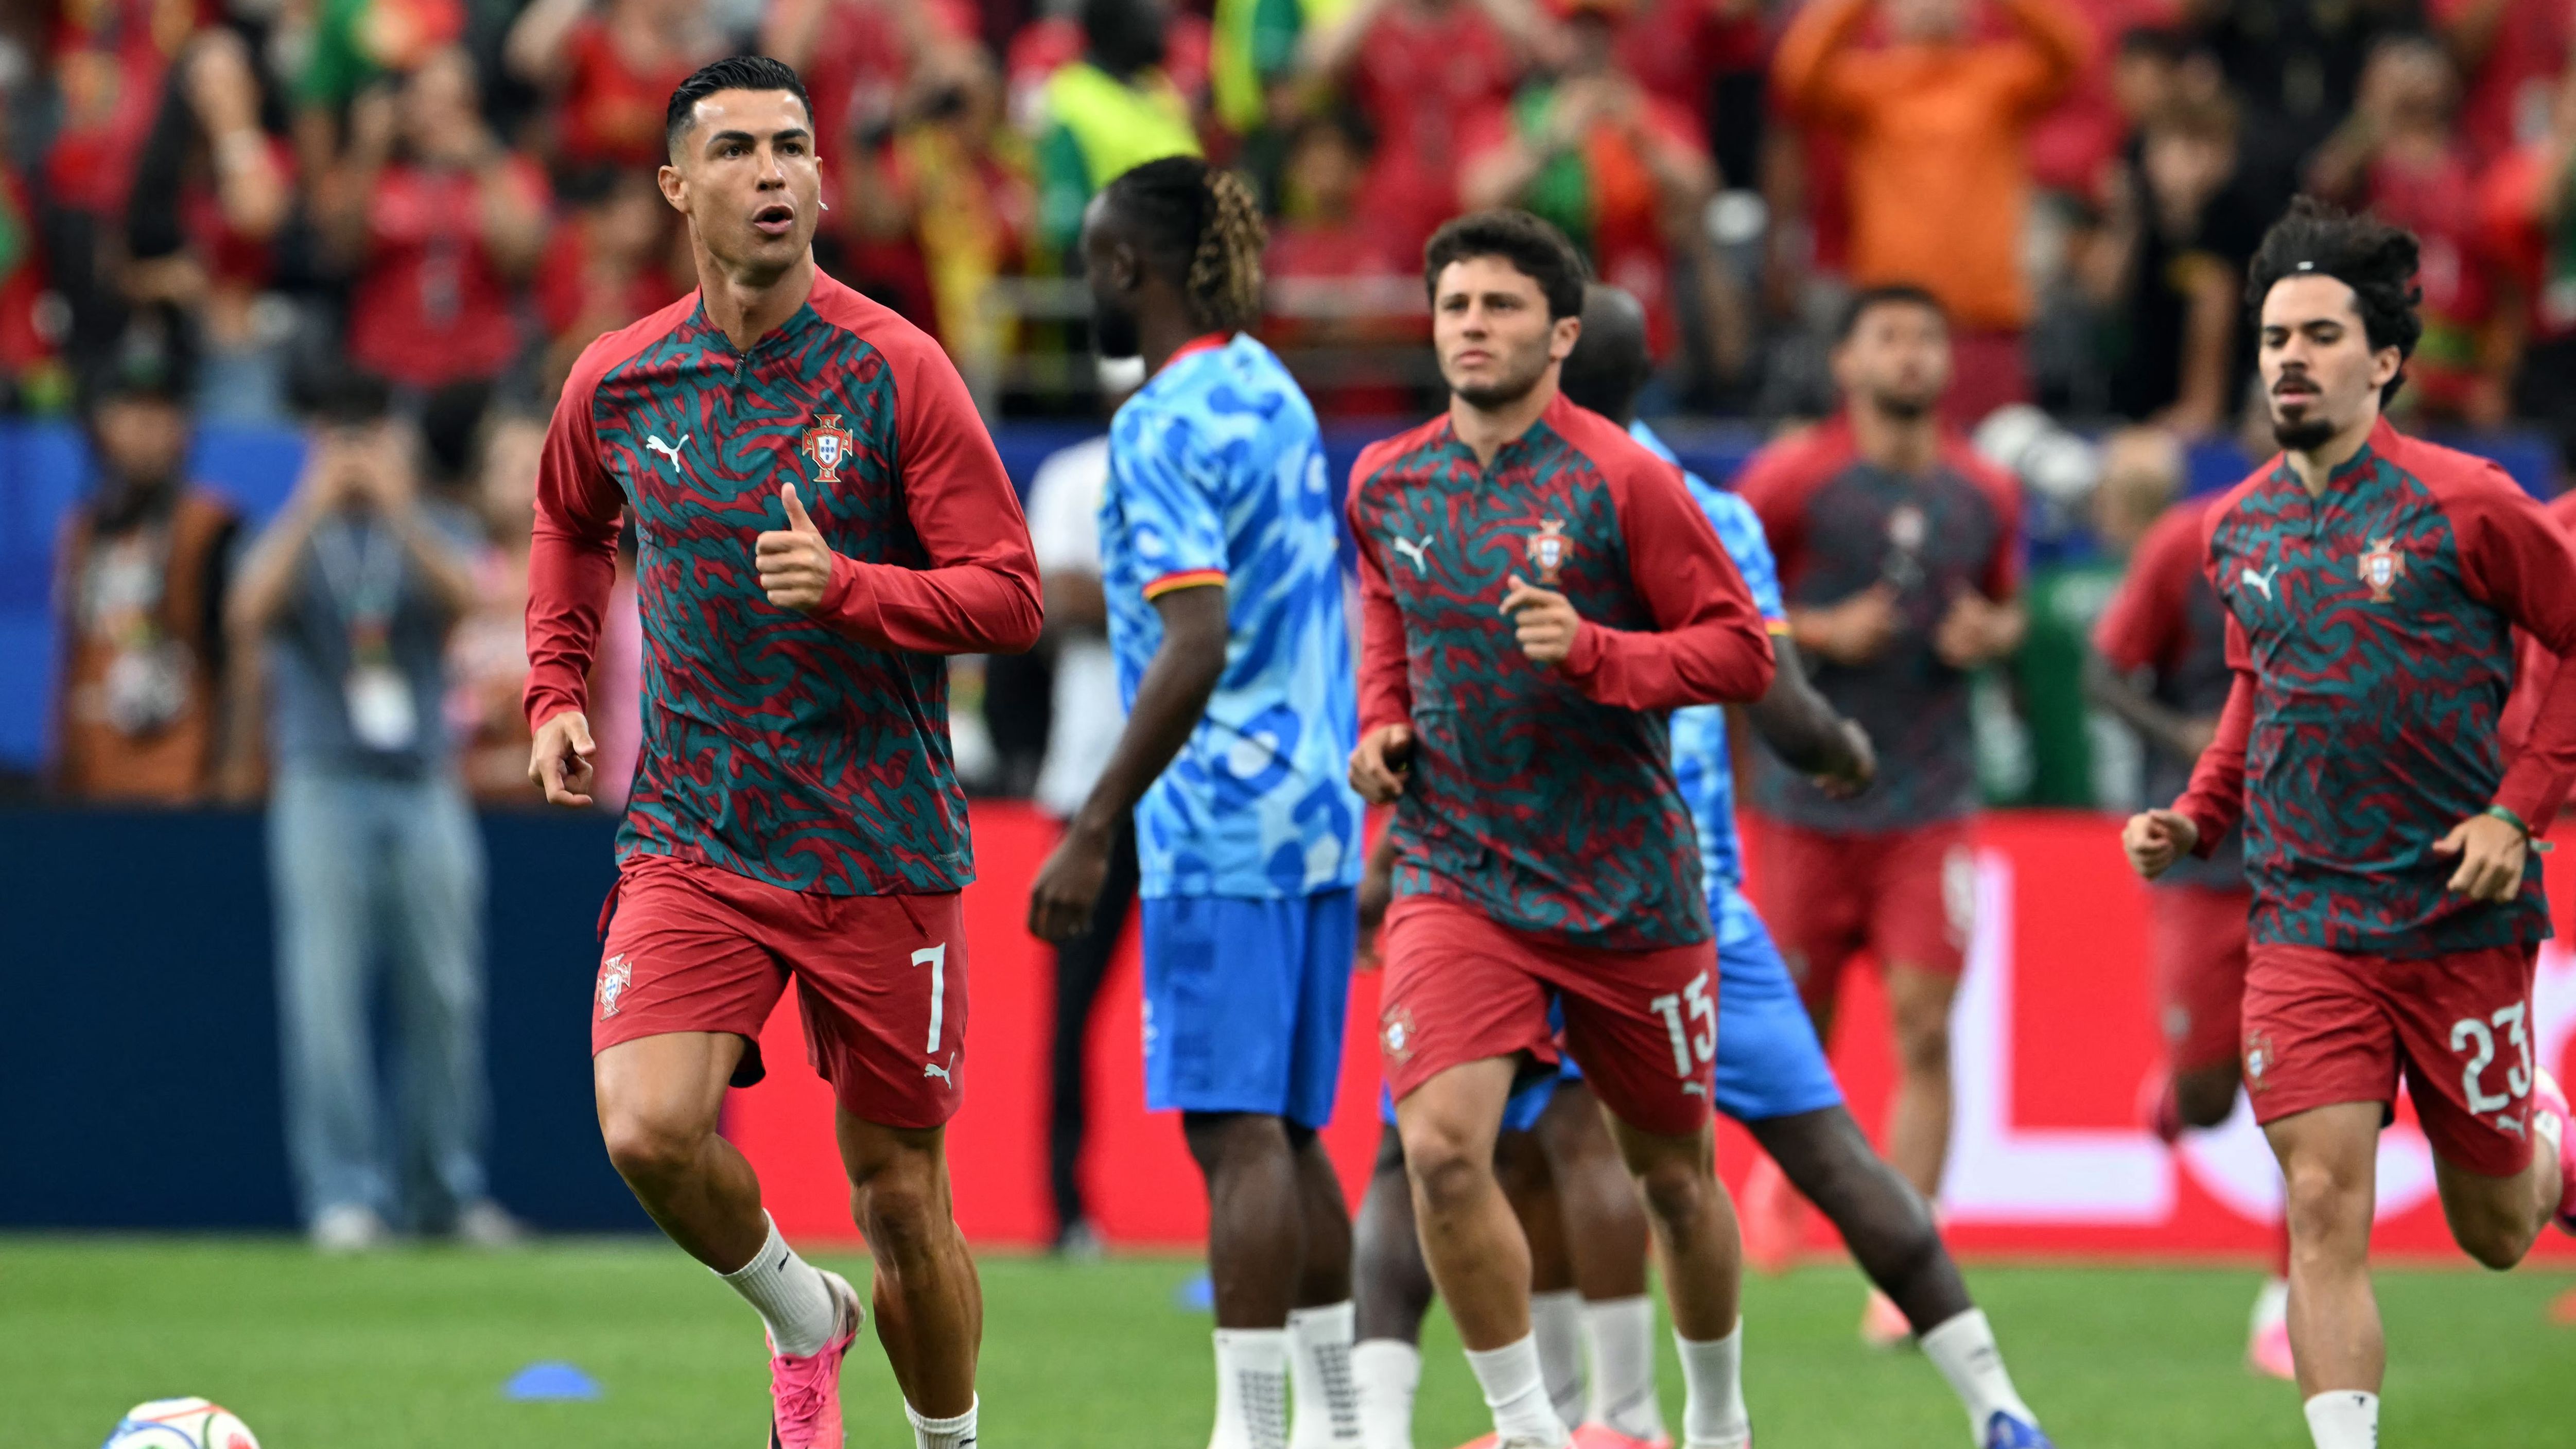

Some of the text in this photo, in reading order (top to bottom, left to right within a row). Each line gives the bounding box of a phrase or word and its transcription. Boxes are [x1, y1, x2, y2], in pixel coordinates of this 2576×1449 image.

[911, 941, 946, 1054] 7
[1650, 970, 1717, 1078] 15
[2450, 1000, 2533, 1115] 23
